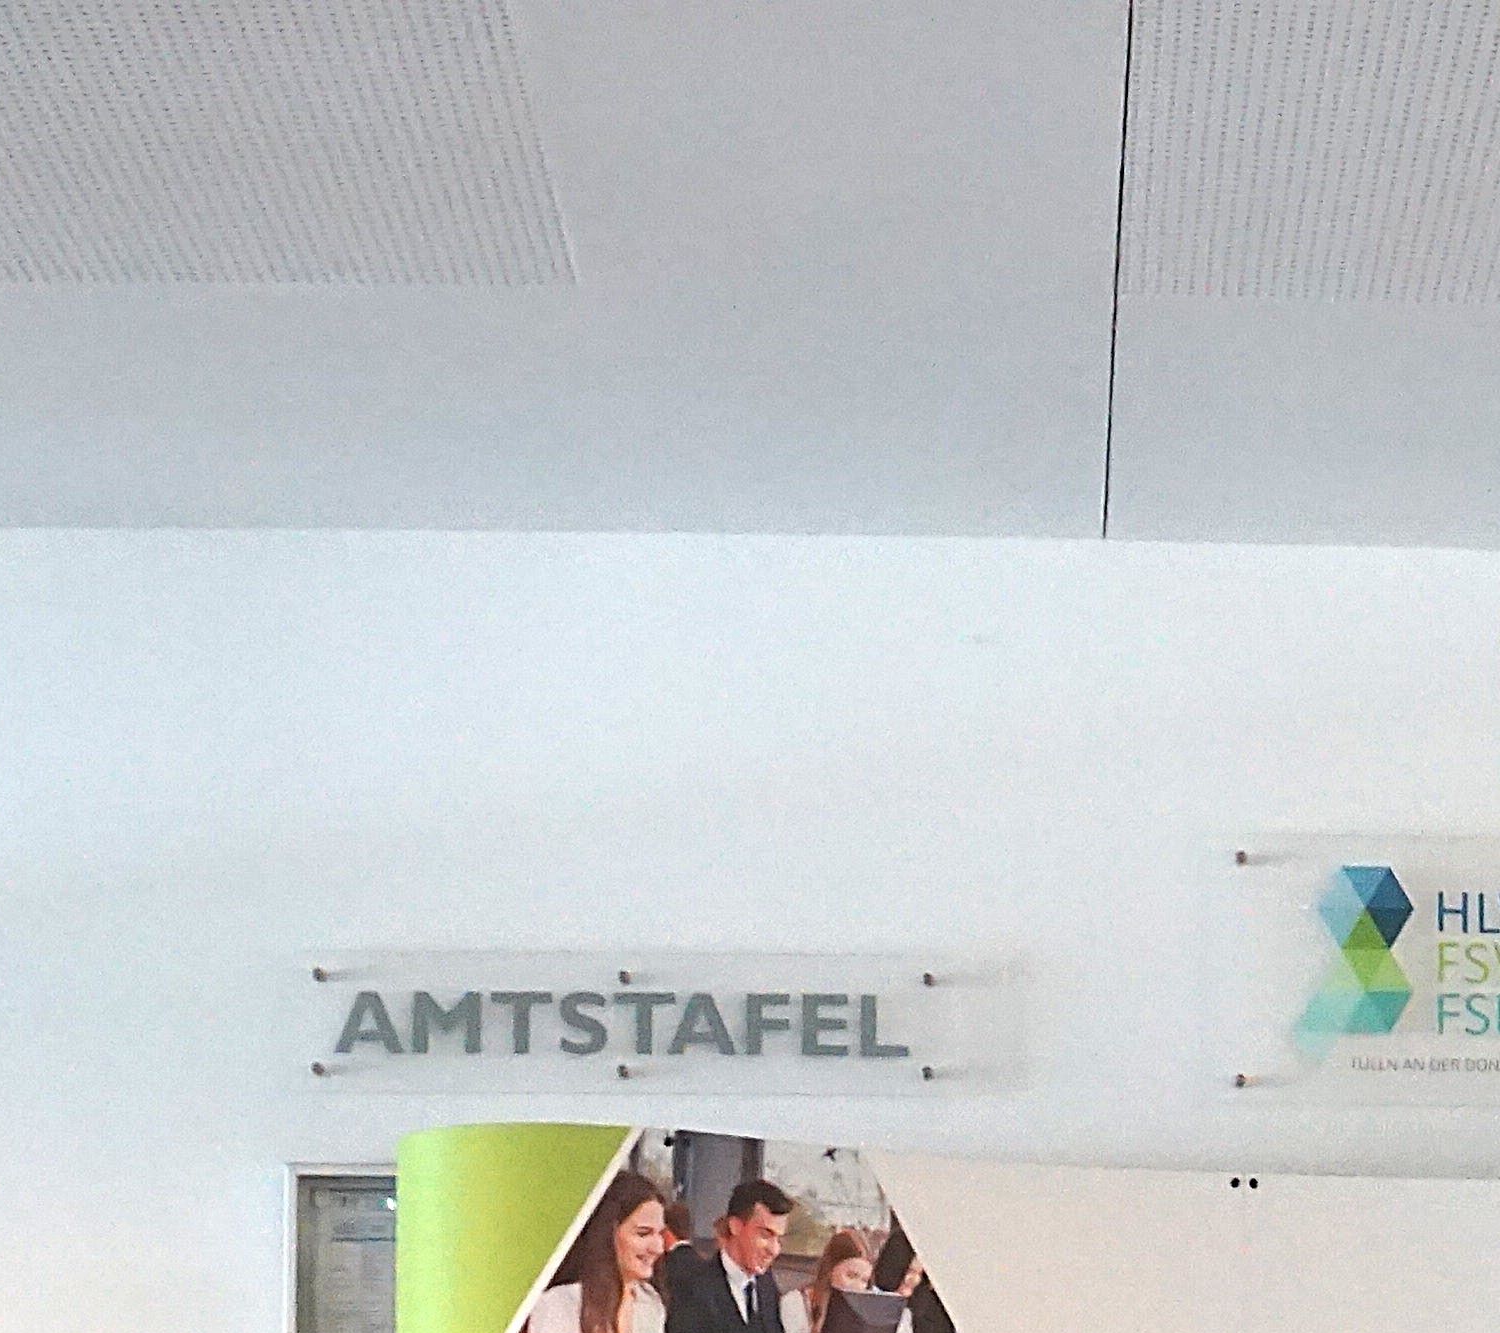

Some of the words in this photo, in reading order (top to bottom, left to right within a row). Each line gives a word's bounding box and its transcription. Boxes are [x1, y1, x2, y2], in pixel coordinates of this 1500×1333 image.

[334, 991, 909, 1056] AMTSTAFEL
[1403, 1057, 1425, 1071] AN
[1429, 1057, 1460, 1072] DER
